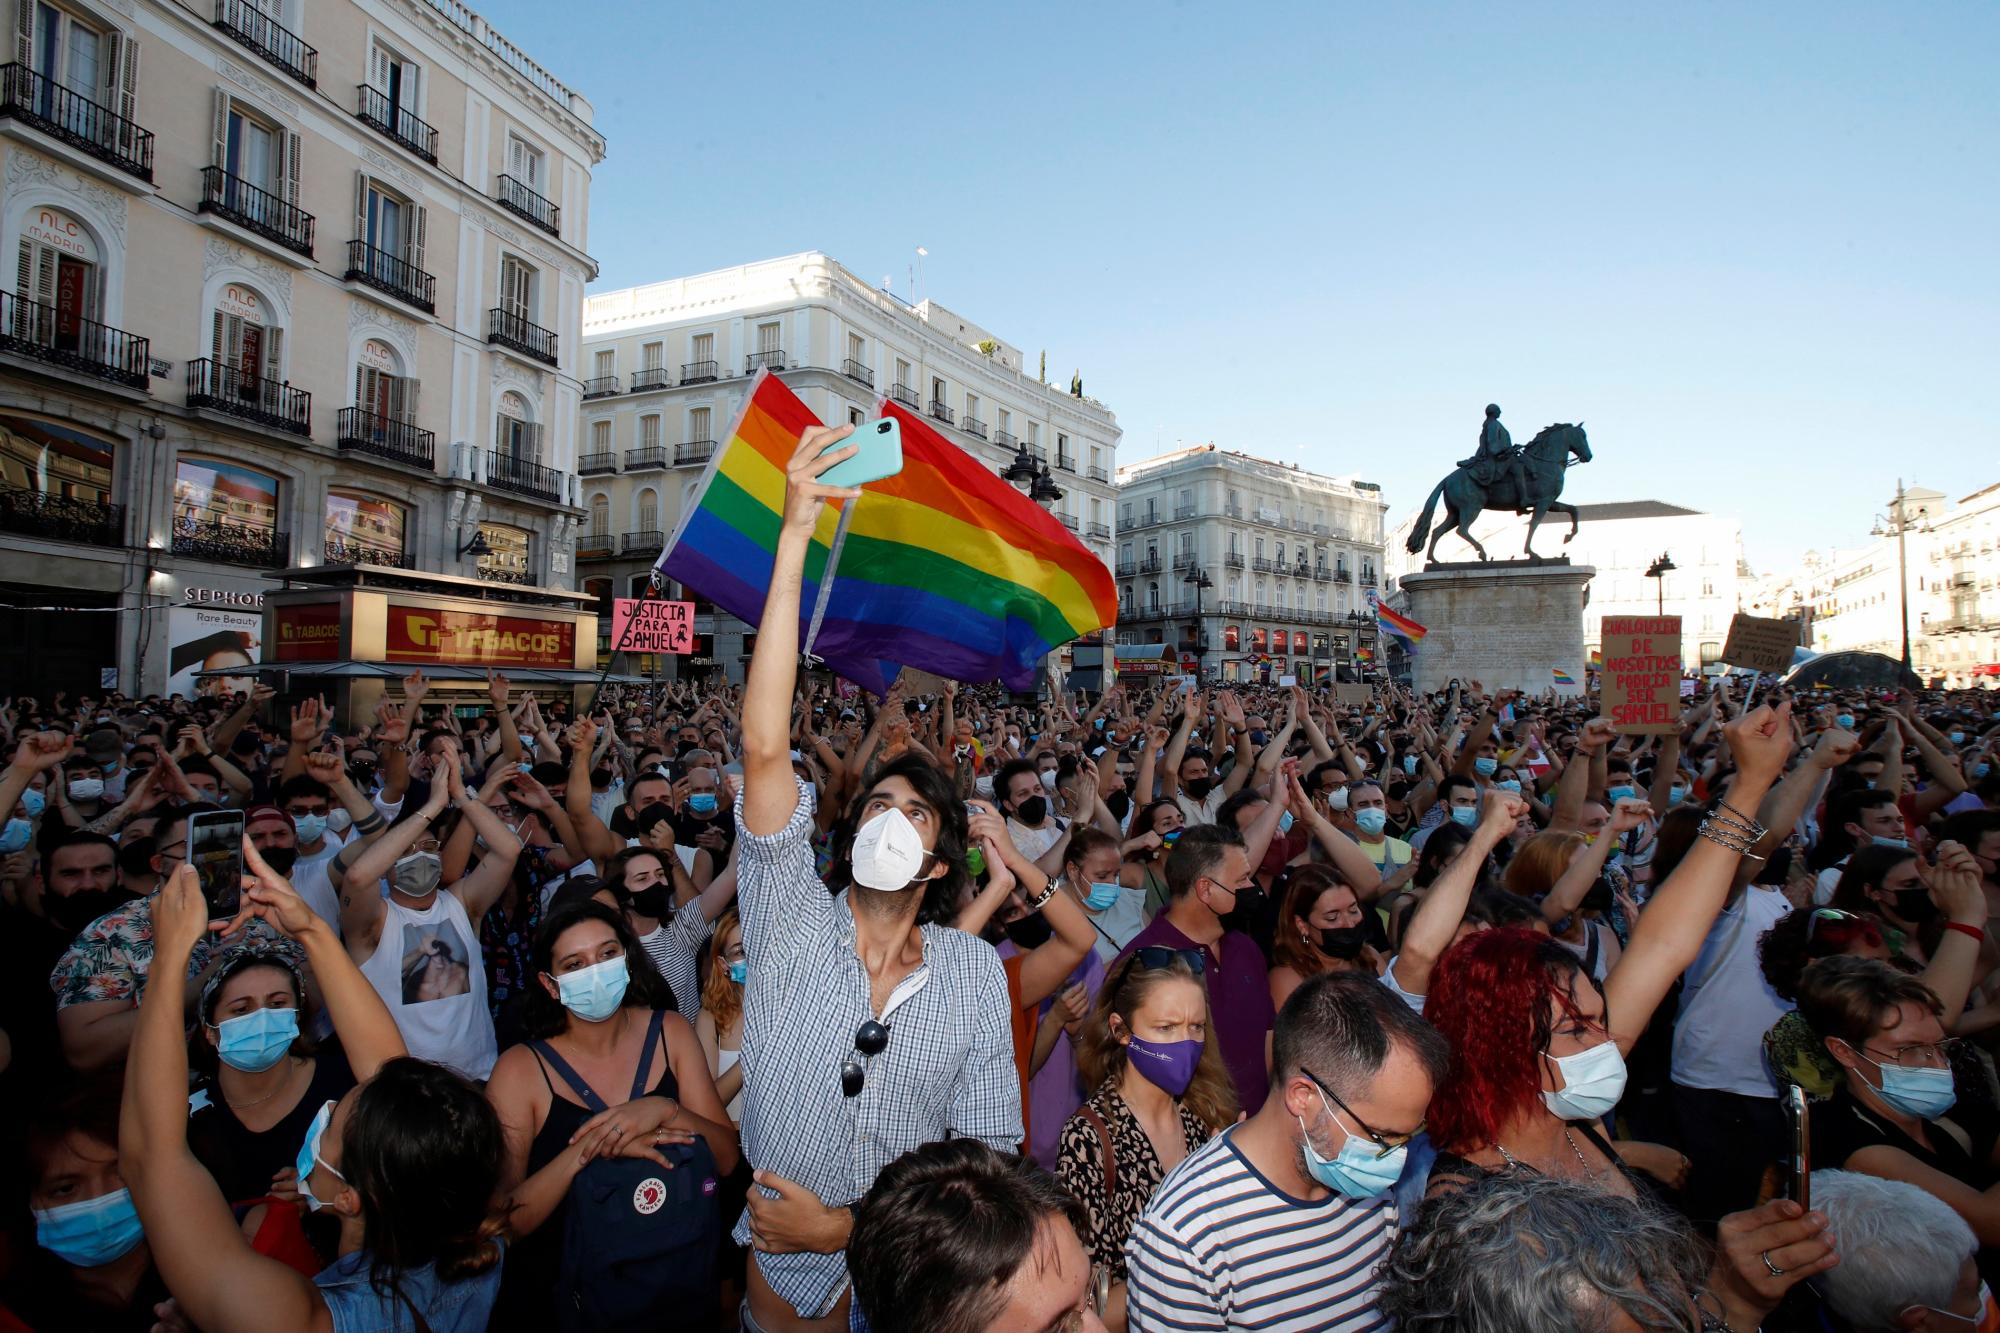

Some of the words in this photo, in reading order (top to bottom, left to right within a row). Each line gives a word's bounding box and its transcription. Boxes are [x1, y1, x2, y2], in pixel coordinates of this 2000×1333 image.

[29, 225, 86, 254] MADRID
[222, 301, 261, 322] MADRID
[361, 354, 392, 371] MADRID
[185, 586, 264, 607] SEPHOR
[197, 612, 221, 624] Rare
[223, 615, 258, 628] Beauty
[622, 602, 686, 621] JUSTICIA
[296, 624, 341, 638] TABACOS
[635, 618, 670, 632] PARA
[454, 627, 560, 654] TABACOS
[620, 630, 679, 652] SAMUEL
[1632, 638, 1653, 654] DE
[1627, 687, 1655, 704] SER
[1611, 703, 1677, 726] SAMUEL
